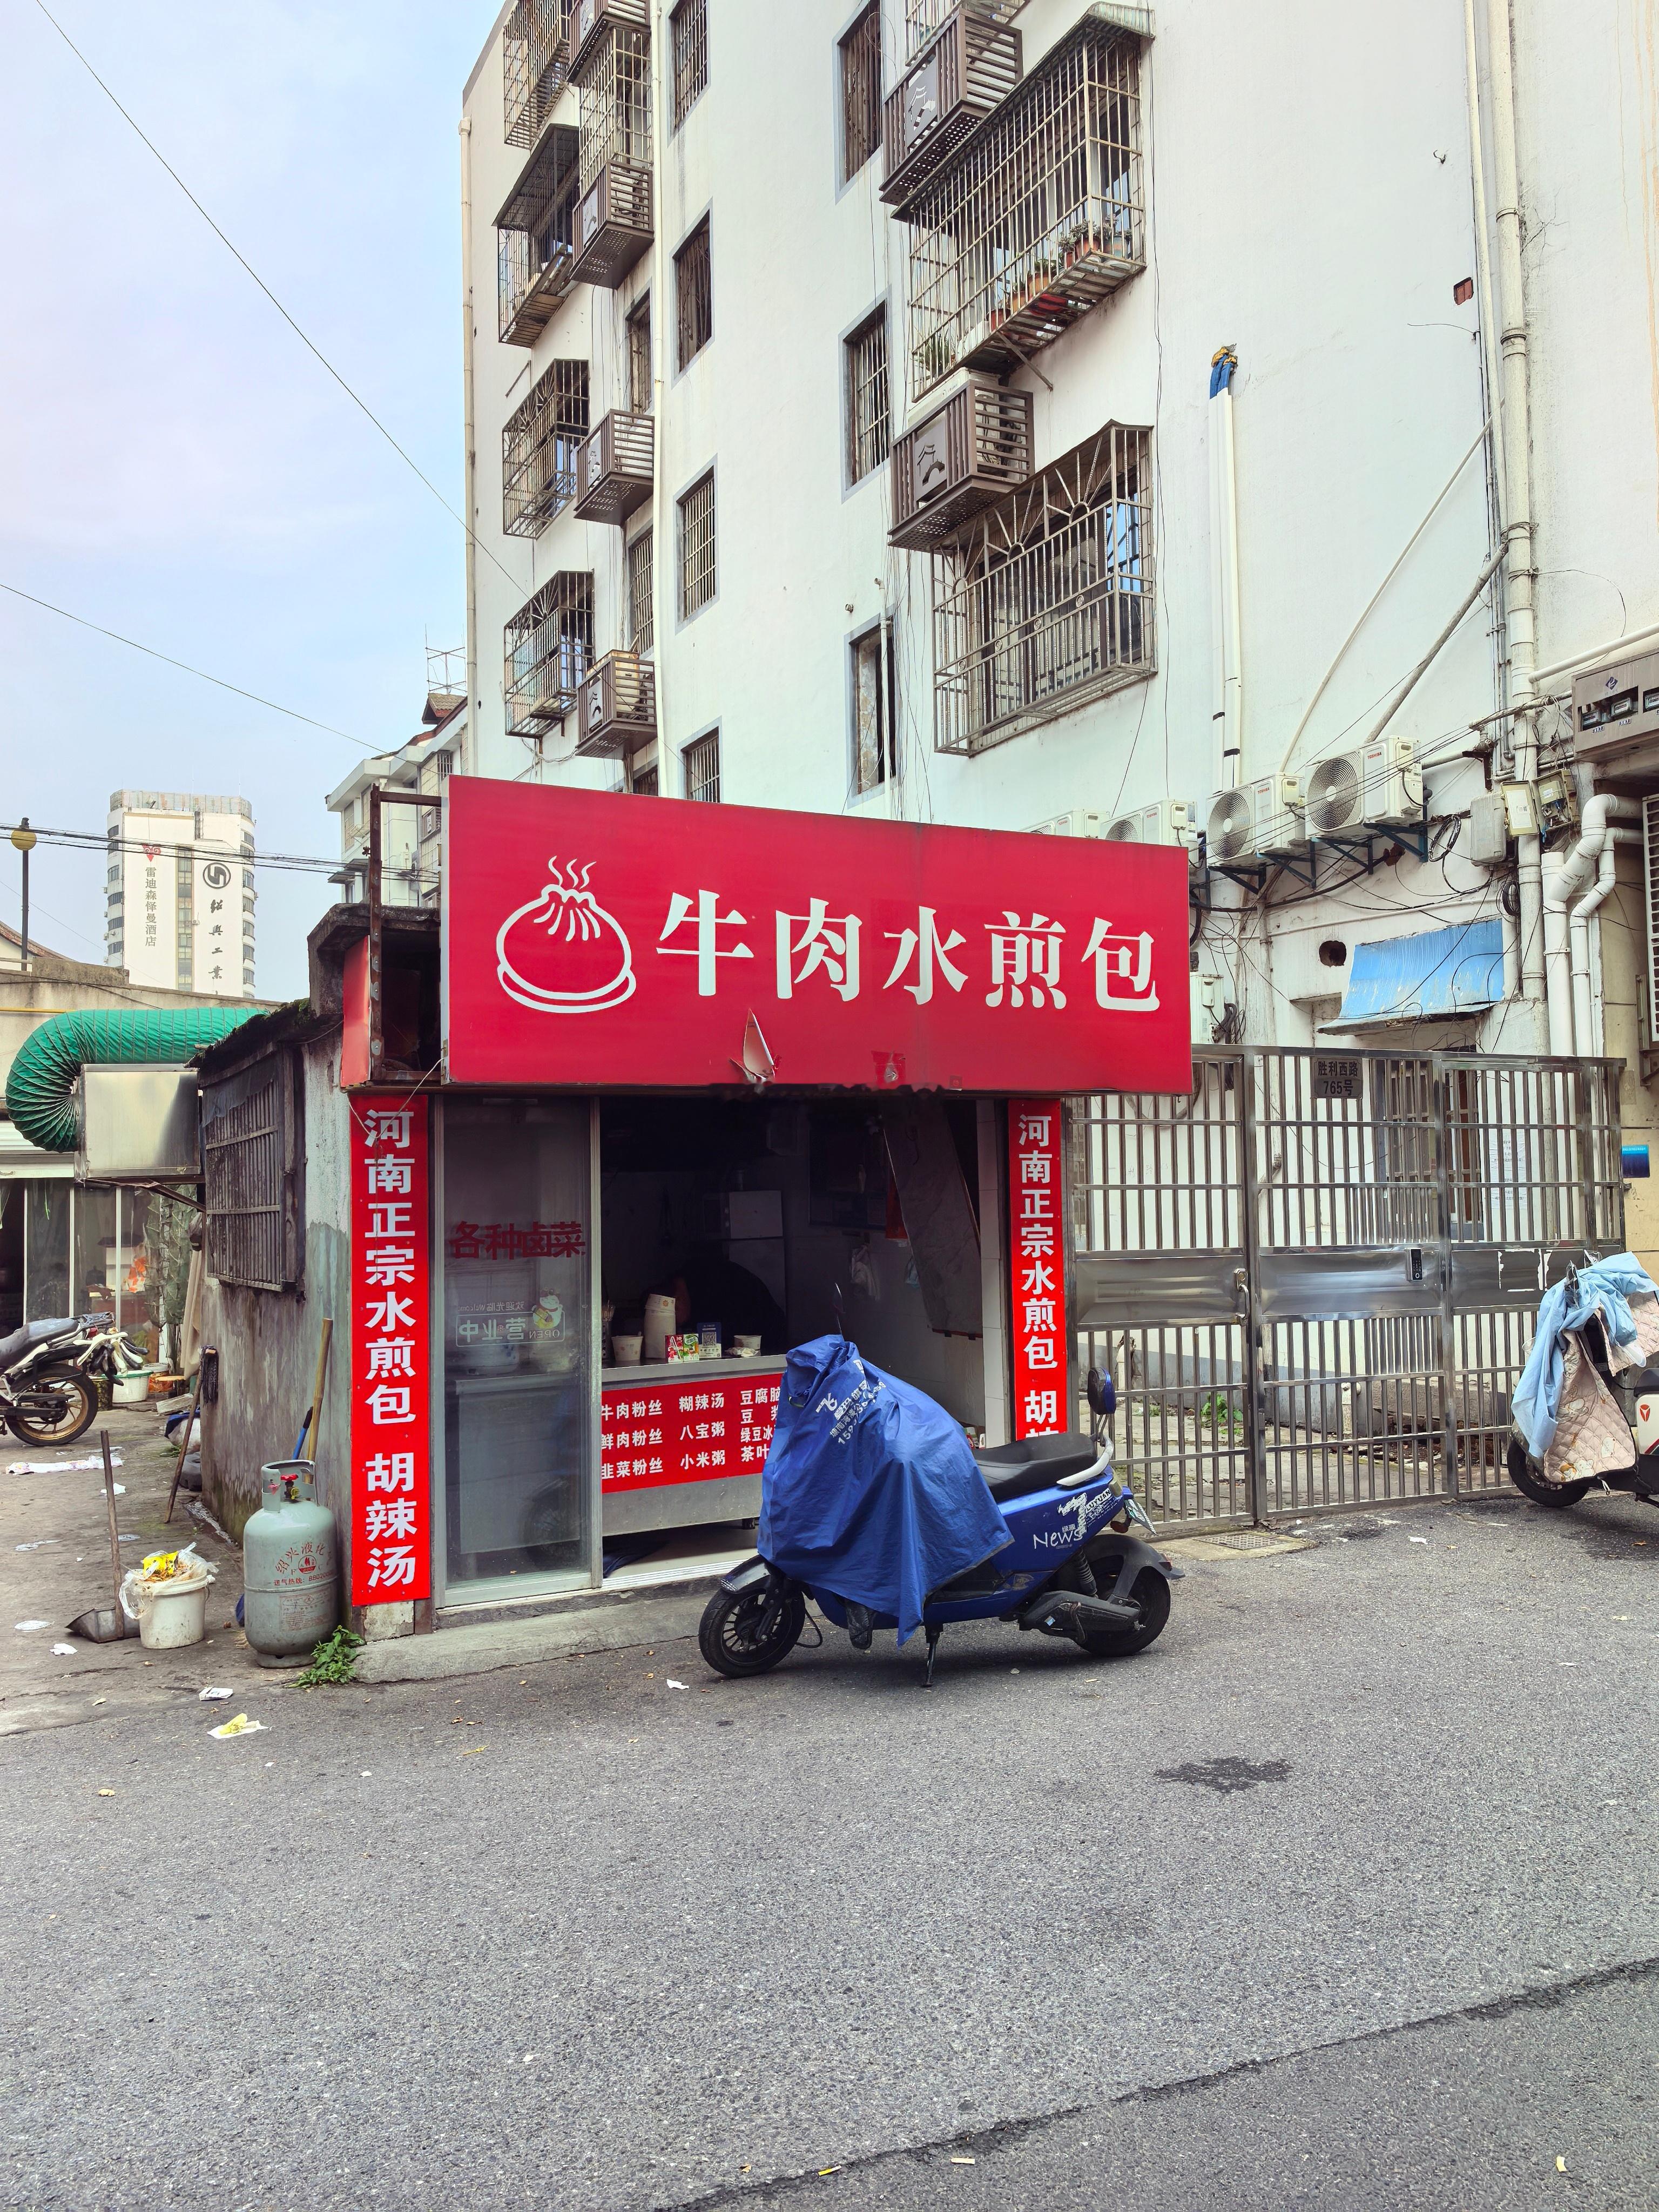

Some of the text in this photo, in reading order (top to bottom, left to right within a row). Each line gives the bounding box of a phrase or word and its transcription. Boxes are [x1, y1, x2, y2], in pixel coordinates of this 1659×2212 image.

[1367, 751, 1382, 760] TOSHIBA
[145, 867, 157, 947] 雷迪森怿曼酒店
[656, 889, 1160, 1012] 牛肉水煎包
[1318, 1061, 1358, 1077] 胜利西路
[1324, 1079, 1353, 1096] 765号
[449, 1220, 585, 1260] 各种卤菜
[1019, 1114, 1058, 1370] 河南正宗水煎包
[365, 1109, 416, 1425] 河南正宗水煎包
[601, 1399, 663, 1421] 牛肉粉丝
[679, 1392, 724, 1413] 糊辣汤
[1024, 1389, 1060, 1438] 胡
[601, 1428, 663, 1450] 鲜肉粉丝
[679, 1421, 725, 1440] 八宝粥
[740, 1424, 776, 1443] 绿豆冰
[602, 1457, 664, 1480] 韭菜粉丝
[680, 1449, 725, 1470] 小米粥
[365, 1452, 417, 1587] 胡辣汤
